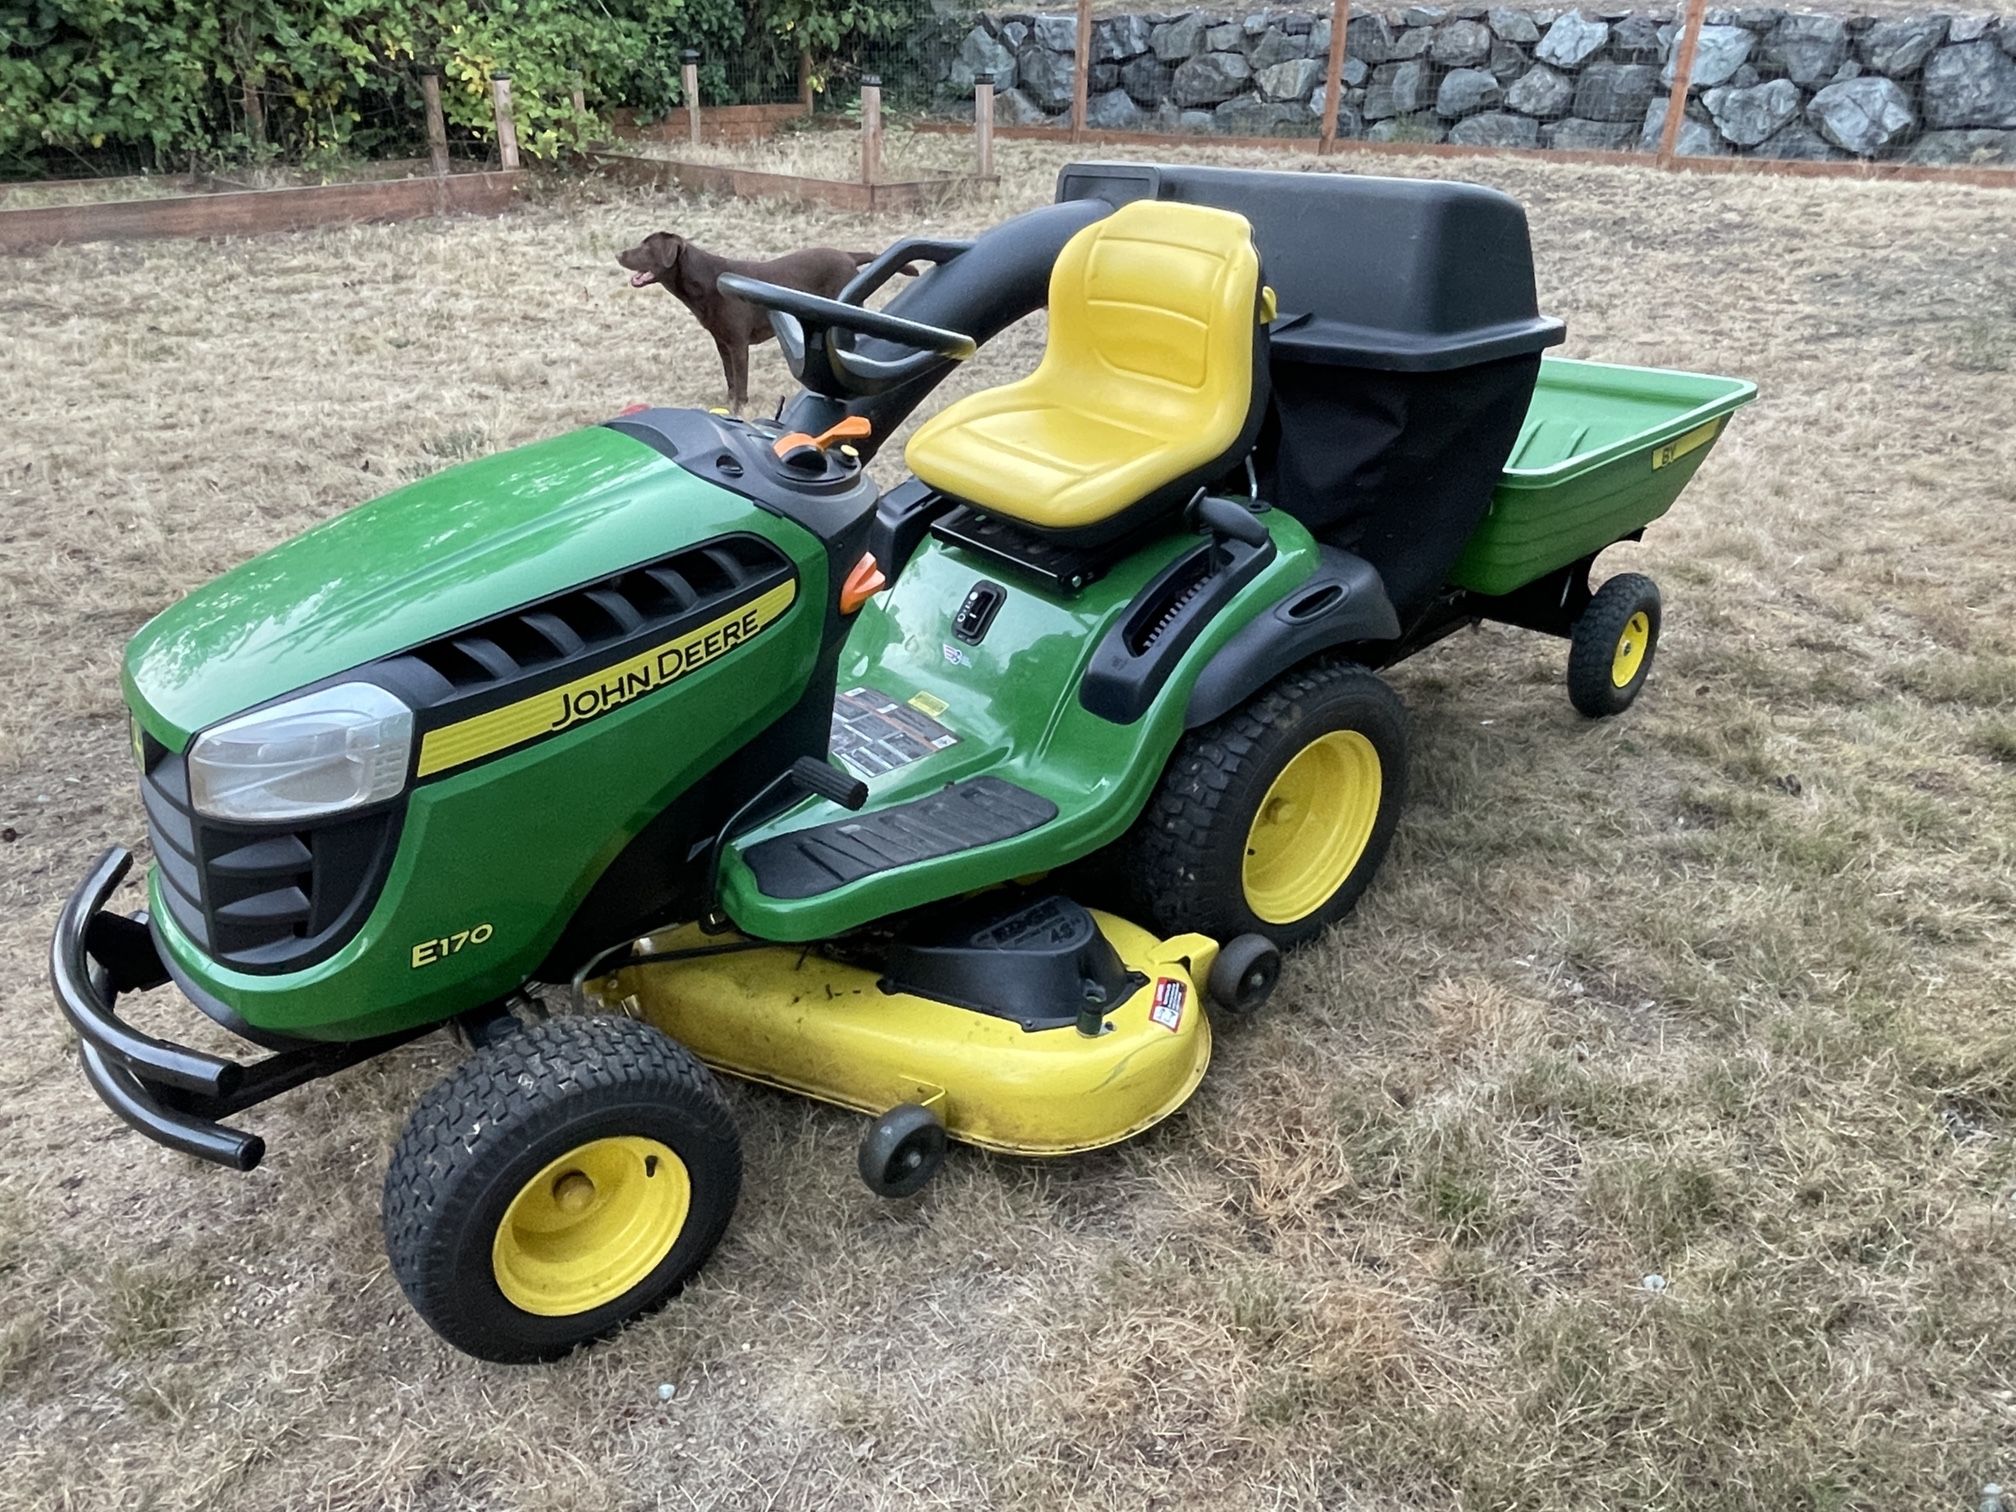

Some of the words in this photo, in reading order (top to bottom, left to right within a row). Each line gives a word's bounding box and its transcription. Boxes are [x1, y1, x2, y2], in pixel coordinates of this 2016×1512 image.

[552, 665, 650, 727] JOHN
[657, 609, 761, 679] DEERE
[411, 923, 494, 969] E170
